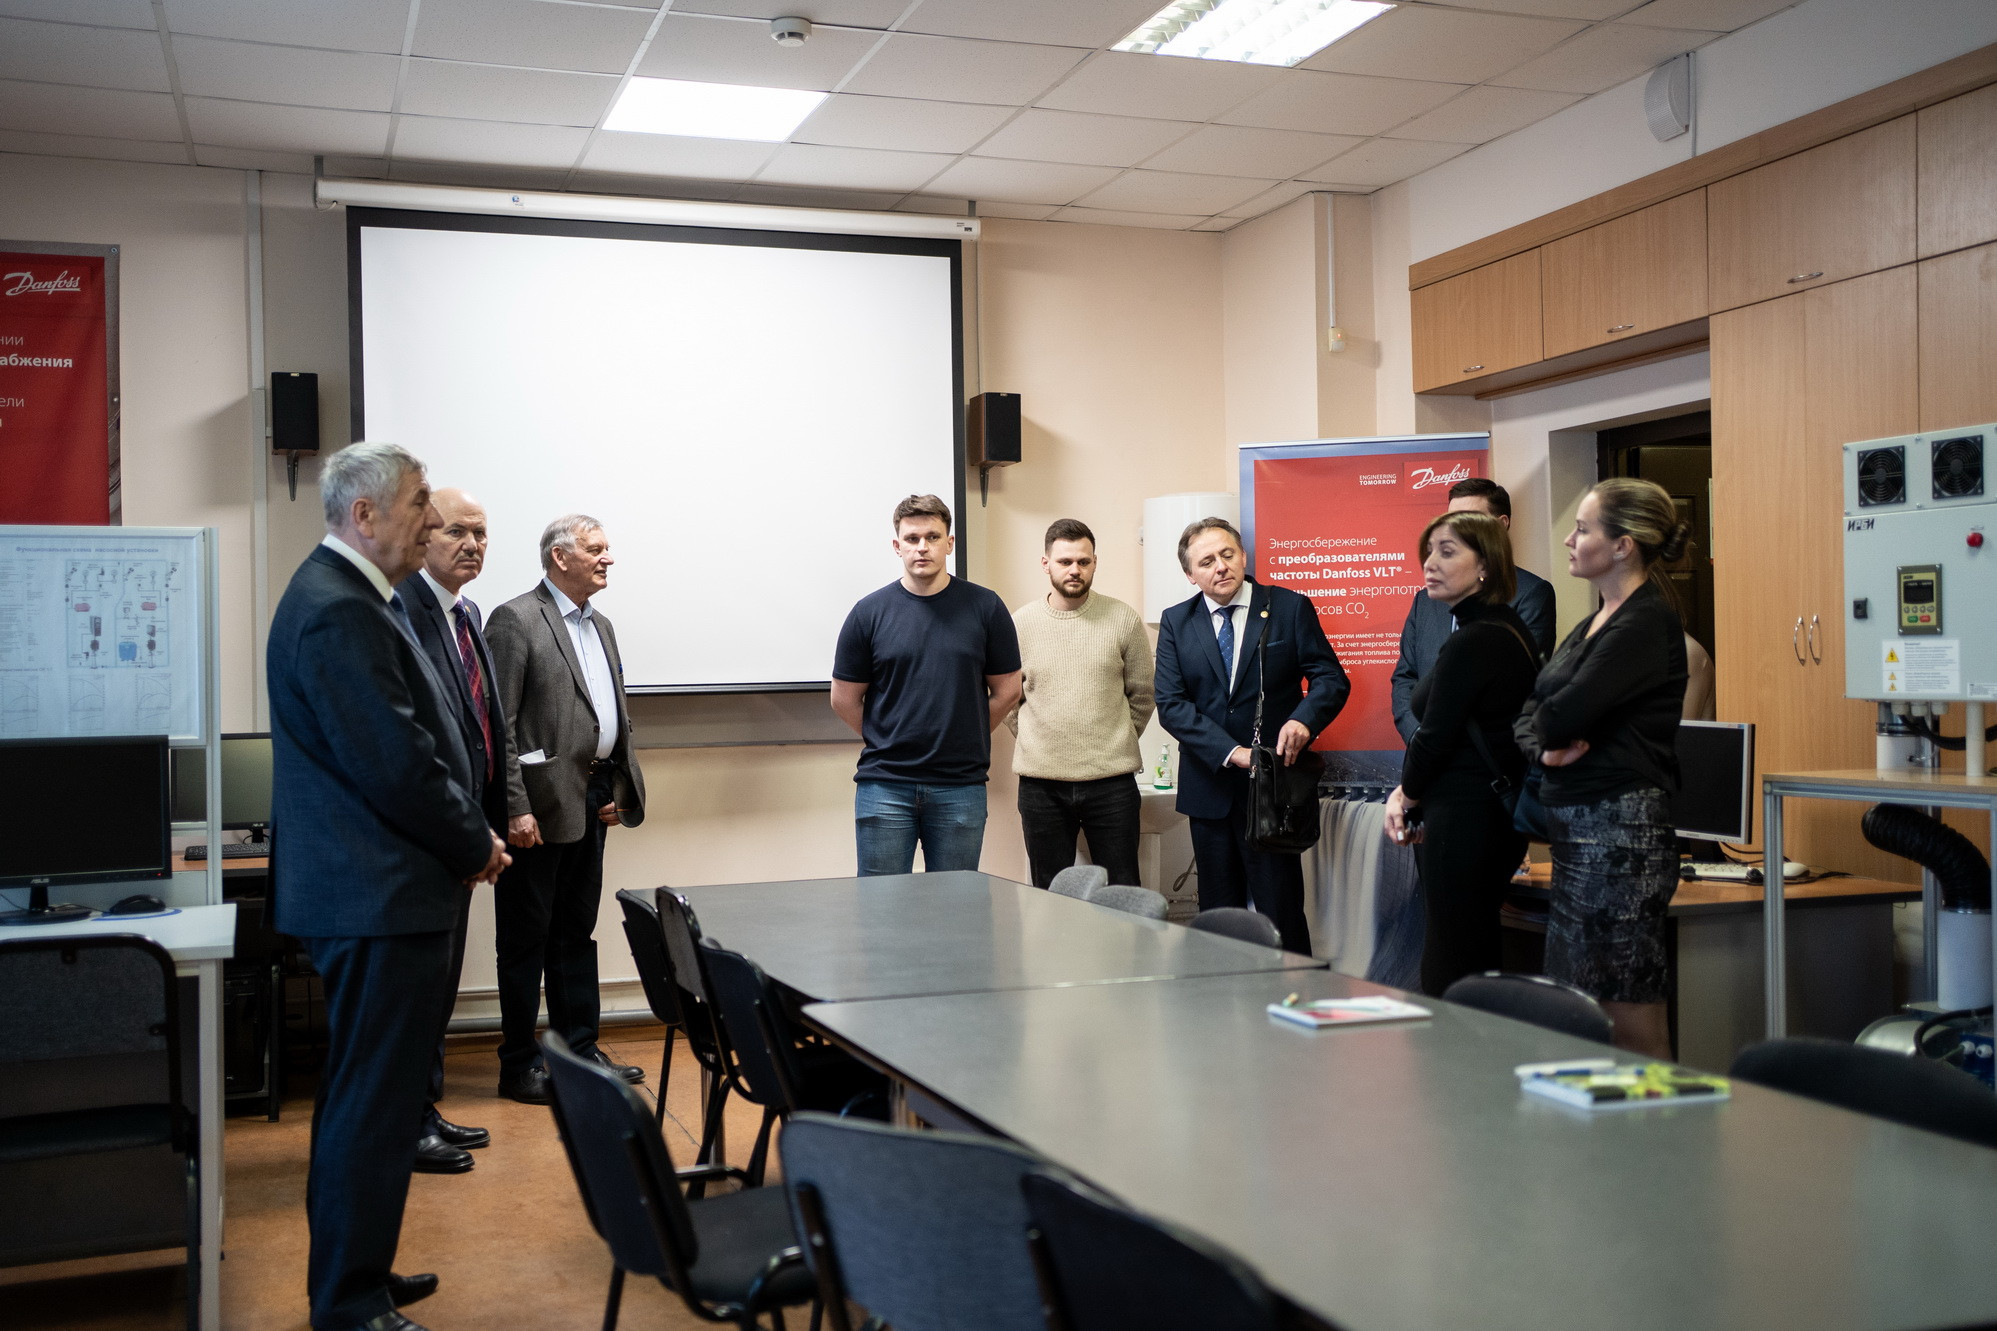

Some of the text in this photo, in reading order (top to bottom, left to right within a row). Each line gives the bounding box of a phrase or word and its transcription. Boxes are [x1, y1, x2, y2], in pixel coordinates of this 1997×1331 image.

[3, 270, 81, 296] Danfoss
[0, 353, 73, 368] абжения
[1411, 463, 1471, 490] Danfoss
[1269, 537, 1377, 550] Энергосбережение
[1269, 552, 1405, 566] с преобразователями
[1269, 570, 1320, 580] частоты
[1322, 568, 1371, 579] Danfoss
